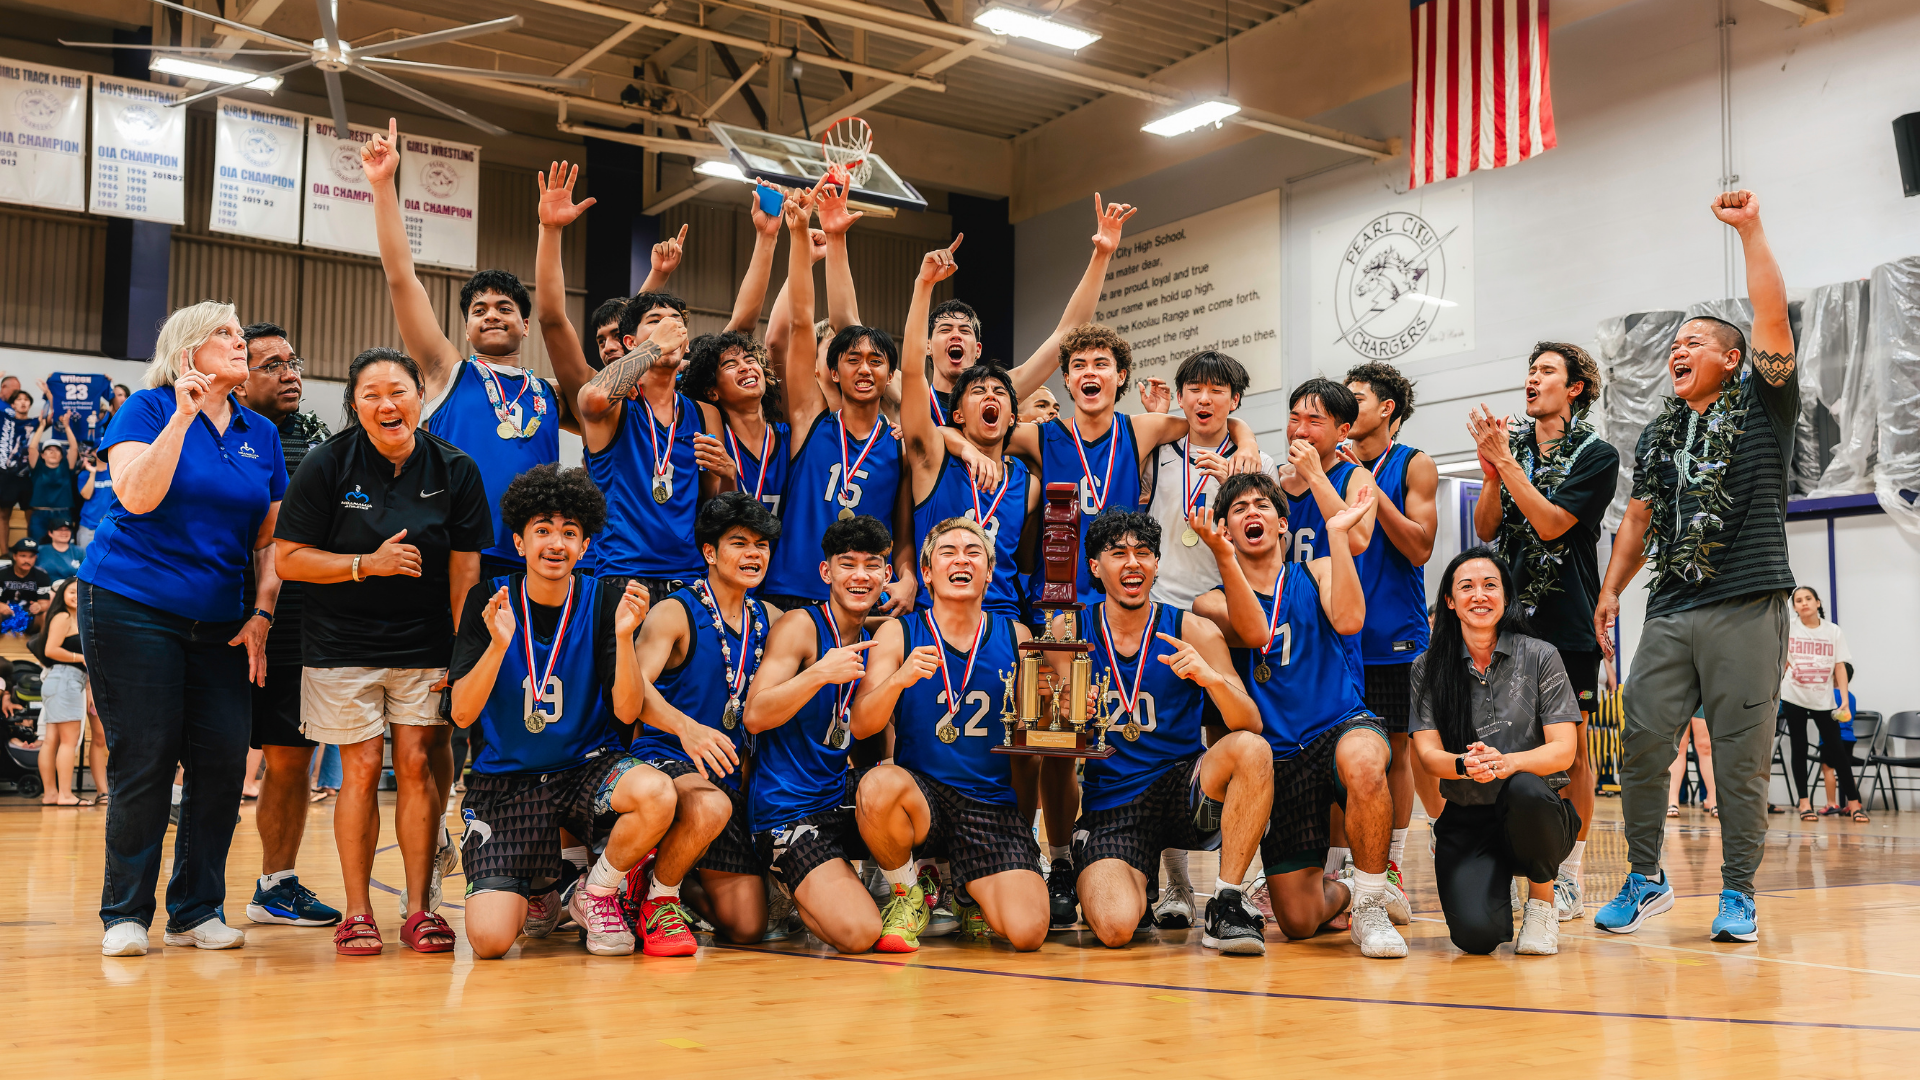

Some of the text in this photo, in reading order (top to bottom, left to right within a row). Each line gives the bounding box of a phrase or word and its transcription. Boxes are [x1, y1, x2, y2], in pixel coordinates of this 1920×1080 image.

[23, 69, 50, 85] TRACK
[52, 75, 58, 85] &
[61, 75, 81, 89] FIELD
[100, 82, 178, 104] BOYS VOLLEYBALL
[223, 104, 299, 129] GIRLS VOLLEYBALL
[0, 131, 79, 153] IA CHAMPION
[316, 123, 337, 138] BOYS
[98, 146, 178, 168] OIA CHAMPION
[406, 140, 474, 162] GIRLS WRESTLING
[220, 165, 295, 189] OIA CHAMPION
[313, 183, 374, 203] OIA CHAMPI
[404, 199, 473, 219] OIA CHAMPION
[1116, 246, 1132, 259] City
[1134, 239, 1152, 253] High
[1346, 217, 1433, 265] PEARL CITY
[1116, 263, 1139, 277] mater
[1141, 258, 1163, 271] dear,
[1109, 289, 1122, 300] are
[1124, 280, 1150, 297] proud,
[1152, 272, 1171, 287] loyal
[1173, 267, 1189, 280] and
[1191, 263, 1209, 276] true
[1095, 311, 1104, 321] To
[1106, 308, 1119, 319] our
[1121, 302, 1143, 315] name
[1146, 297, 1158, 308] we
[1160, 291, 1179, 304] hold
[1181, 288, 1192, 299] up
[1117, 324, 1129, 335] the
[1131, 317, 1160, 331] Koolau
[1162, 309, 1189, 323] Range
[1192, 305, 1205, 315] we
[1208, 298, 1233, 311] come
[1132, 326, 1198, 350] accept the right
[1170, 345, 1200, 361] honest
[1202, 340, 1219, 351] and
[1221, 337, 1239, 349] true
[1242, 334, 1251, 344] to
[1254, 329, 1277, 341] thee,
[1352, 317, 1427, 356] CHARGERS
[65, 384, 88, 400] 23
[824, 462, 869, 508] 15
[1788, 637, 1834, 656] Camaro
[522, 674, 563, 723] 19
[935, 690, 990, 737] 22
[1107, 690, 1157, 733] 20
